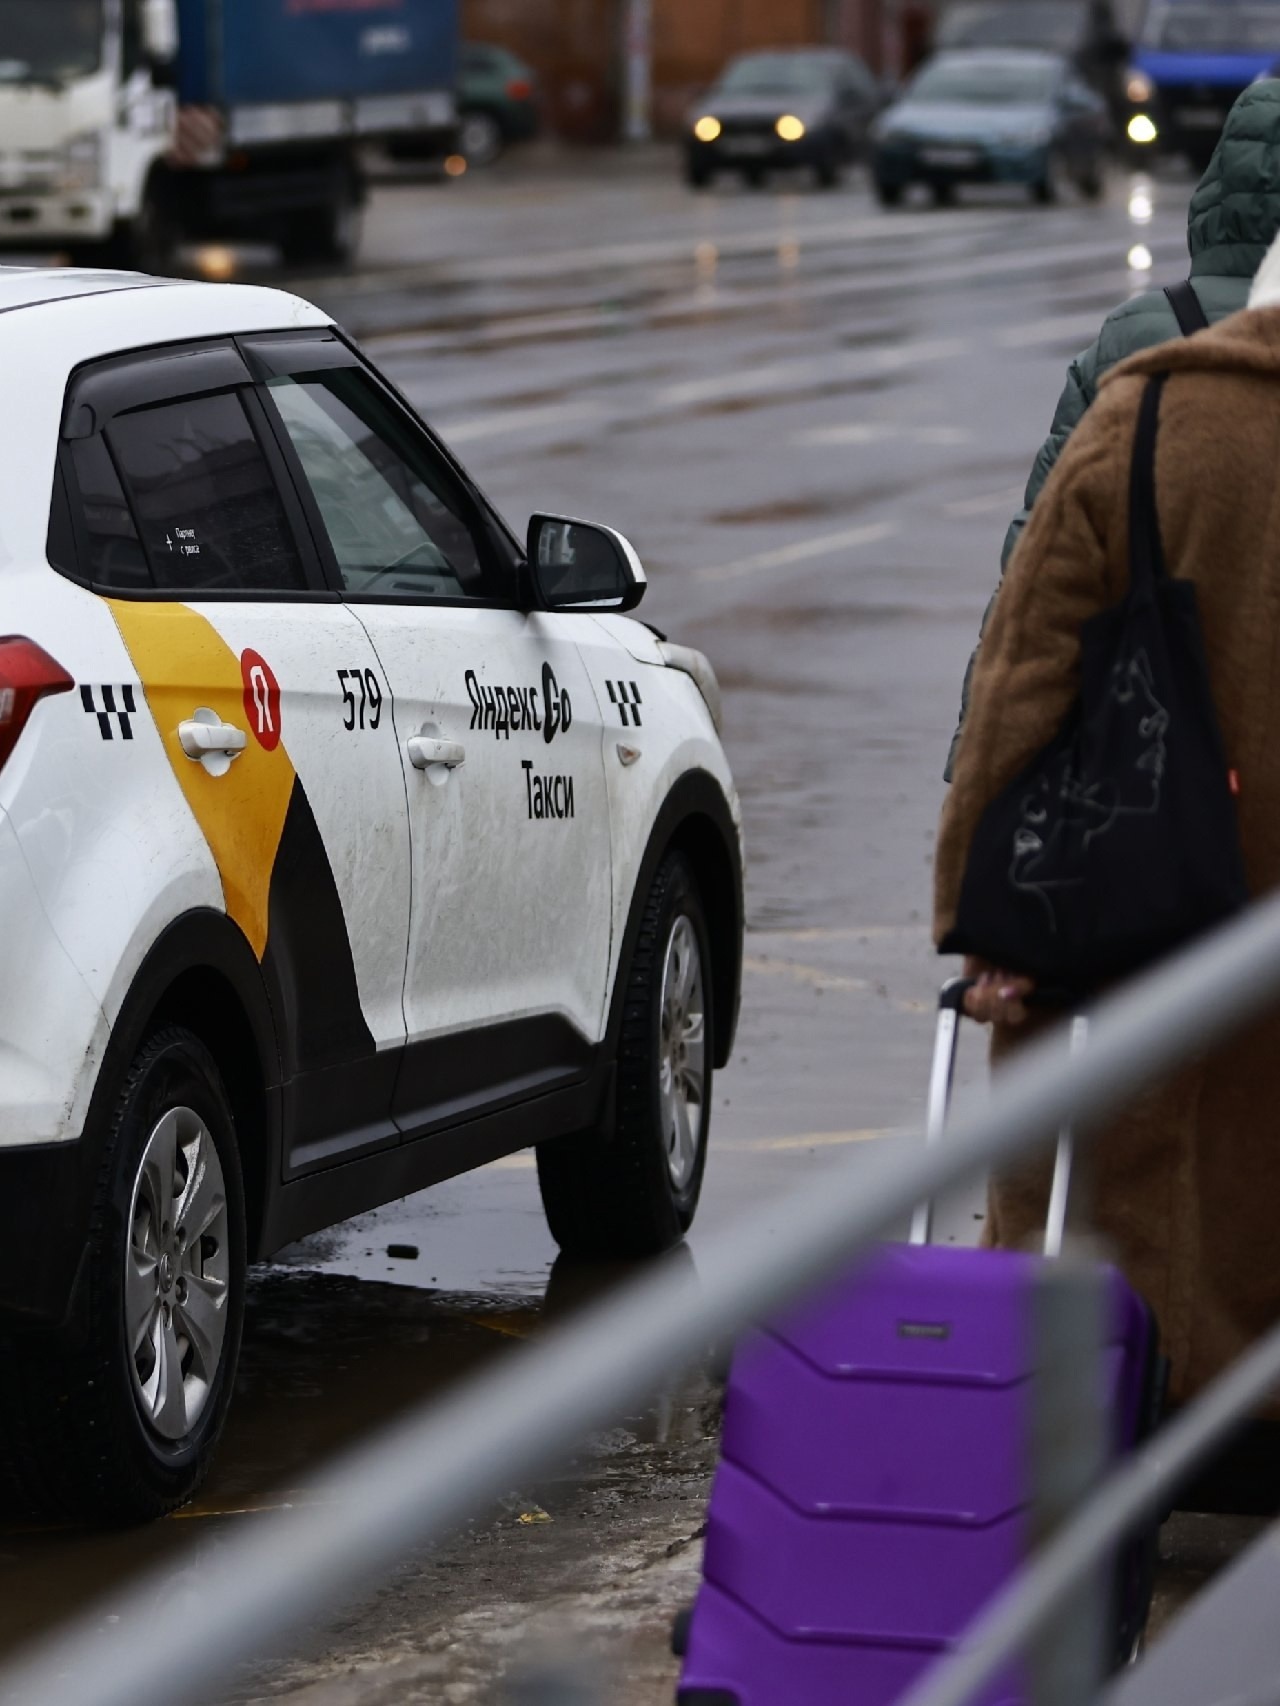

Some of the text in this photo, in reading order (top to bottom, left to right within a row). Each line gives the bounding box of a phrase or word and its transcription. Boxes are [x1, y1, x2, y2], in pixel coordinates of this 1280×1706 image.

[250, 665, 274, 733] Я
[336, 668, 383, 731] 579
[464, 660, 572, 744] Яндекс Go
[521, 760, 575, 819] Такси
